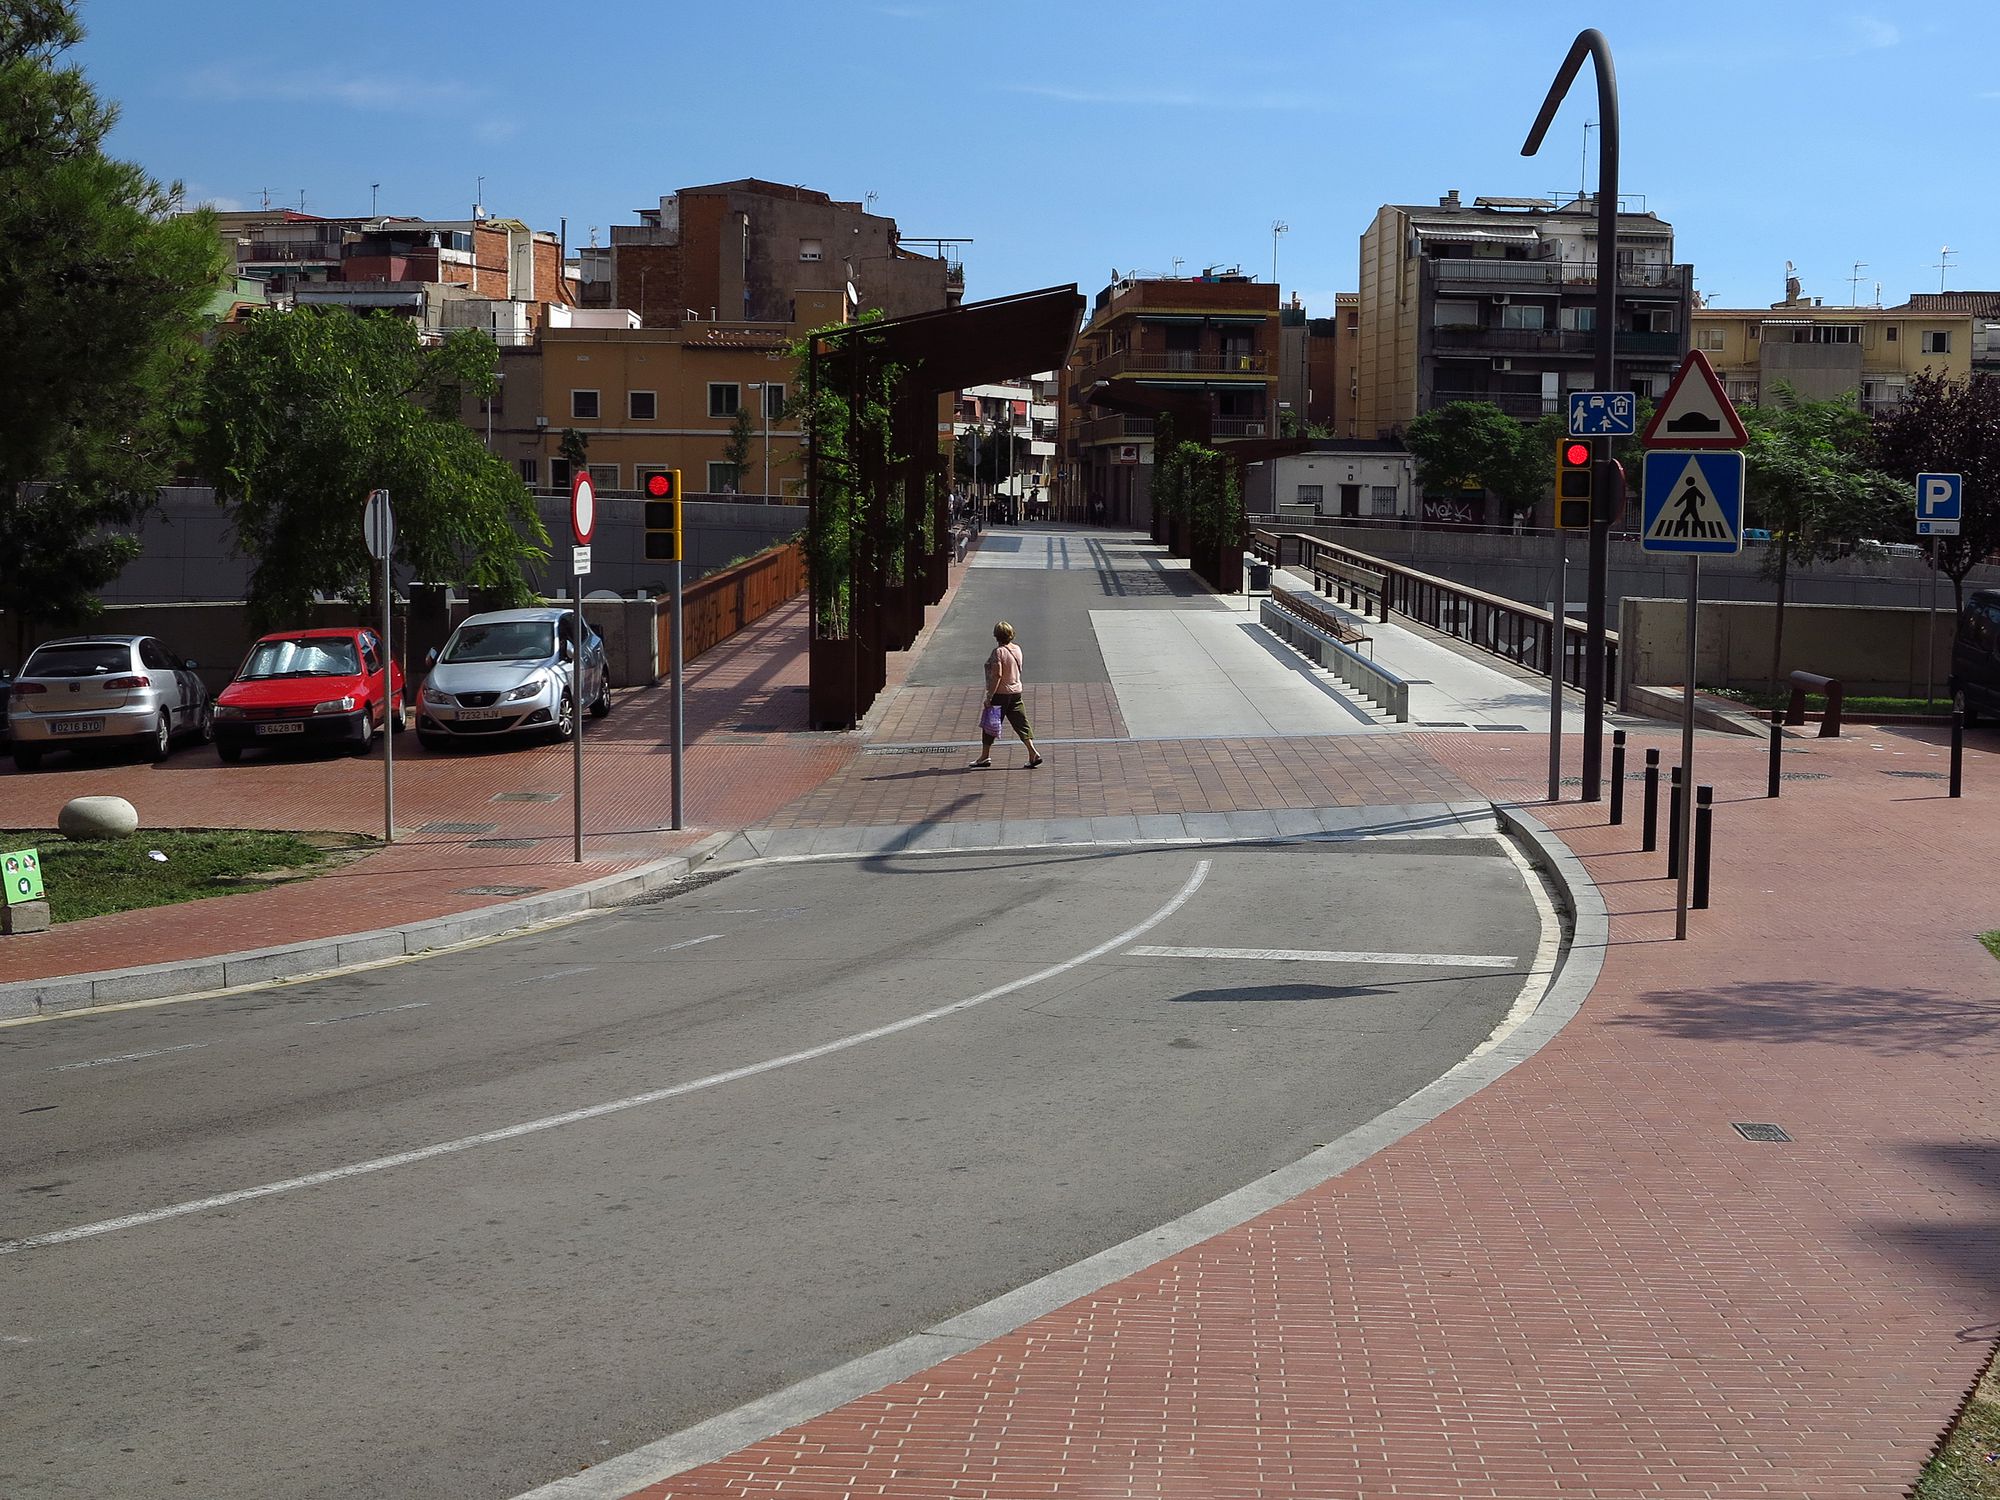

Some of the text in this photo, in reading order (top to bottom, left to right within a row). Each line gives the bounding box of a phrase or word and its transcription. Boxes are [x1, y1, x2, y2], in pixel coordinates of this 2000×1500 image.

[1925, 479, 1953, 514] P
[460, 711, 481, 720] 7232
[57, 722, 80, 732] 0216
